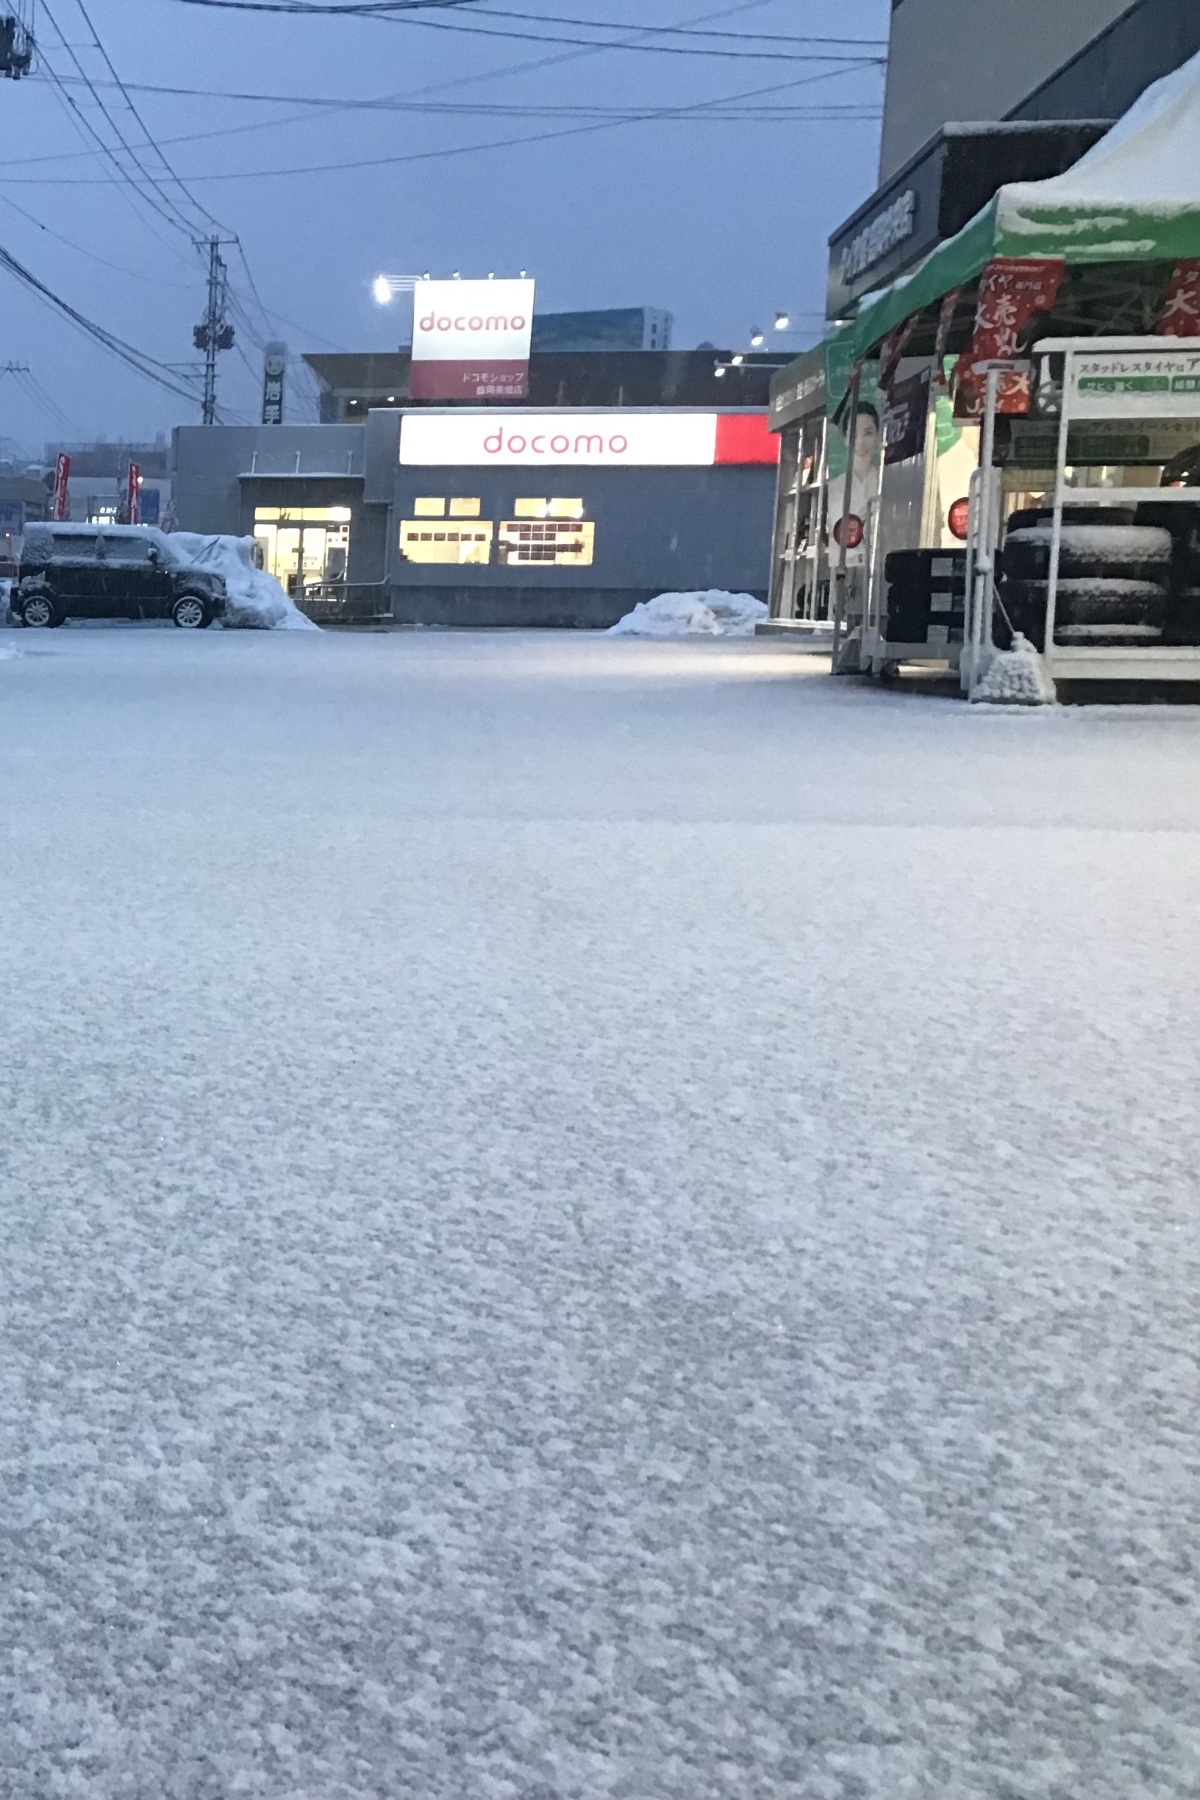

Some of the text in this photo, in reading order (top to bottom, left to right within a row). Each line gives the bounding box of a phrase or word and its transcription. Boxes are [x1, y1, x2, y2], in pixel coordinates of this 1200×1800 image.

[419, 310, 526, 332] docomo
[463, 372, 524, 382] ドコモショップ
[483, 426, 628, 454] docomo
